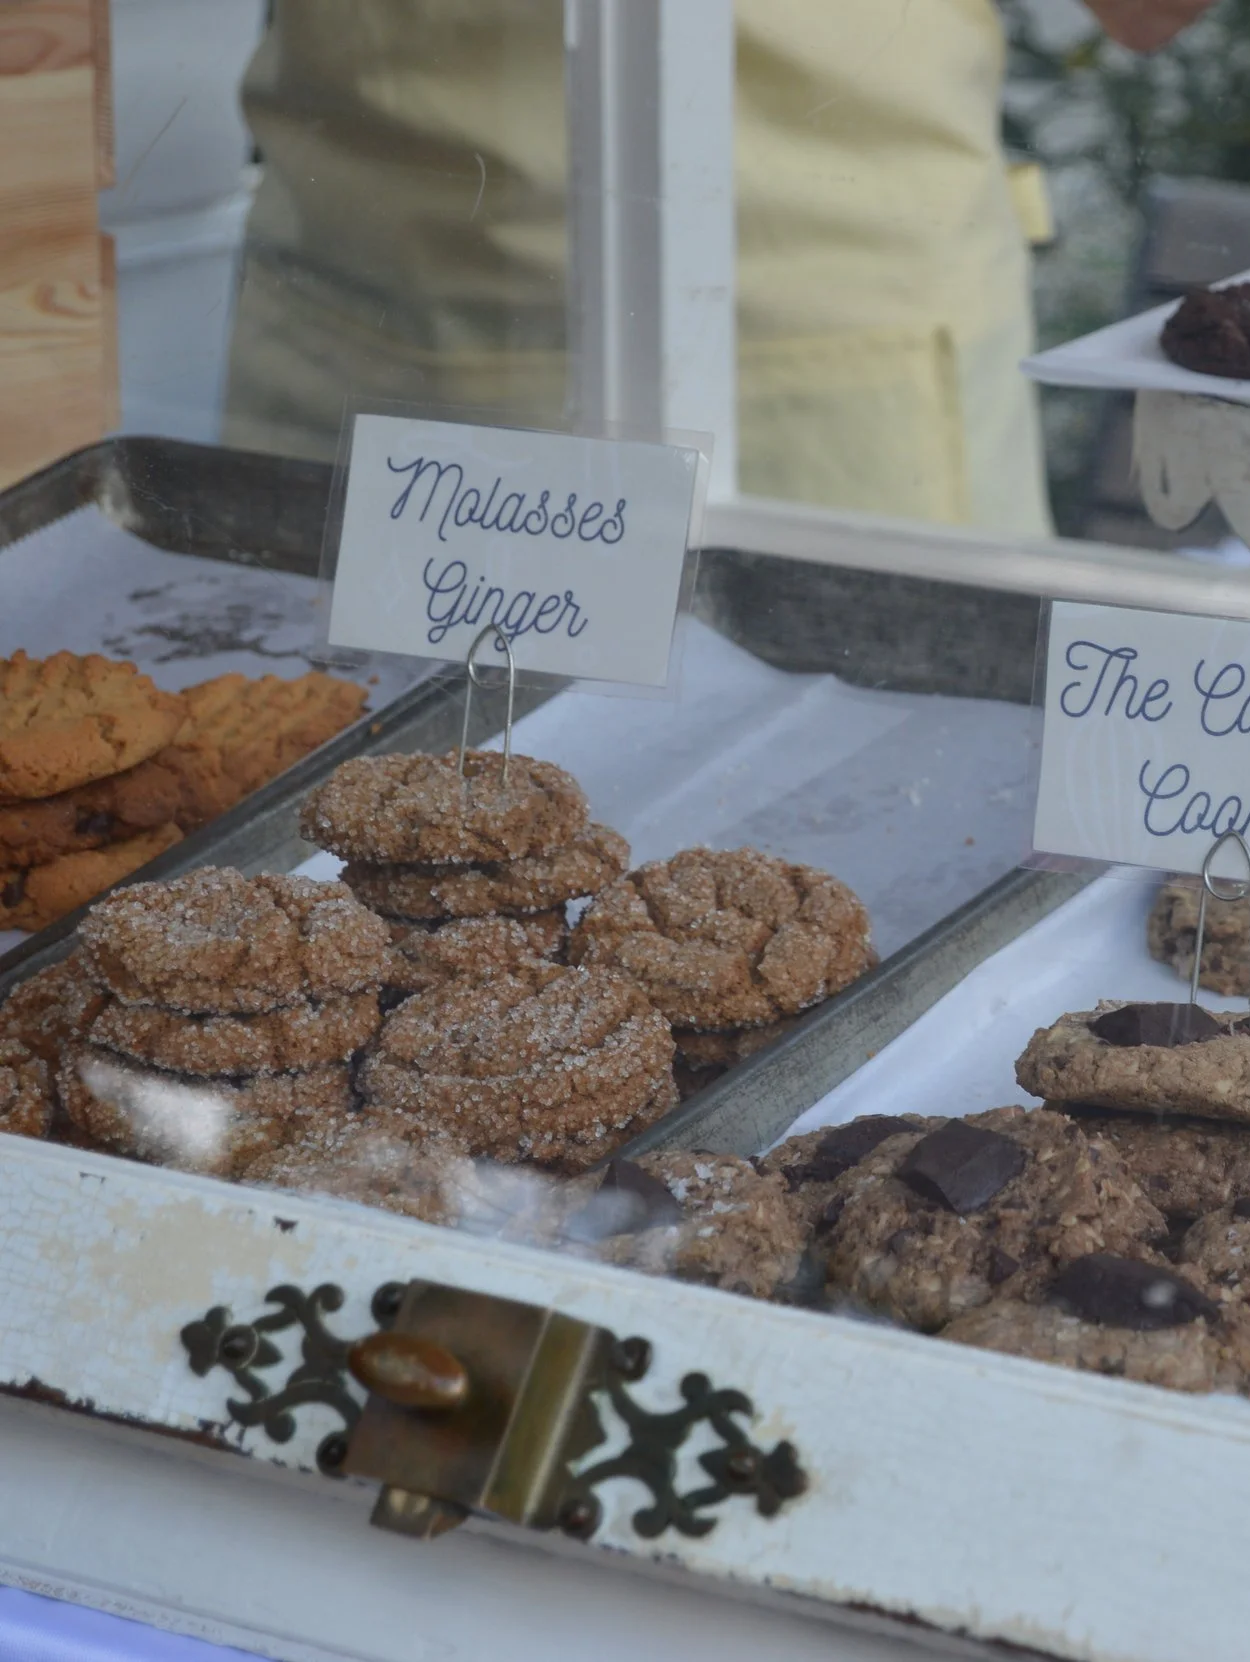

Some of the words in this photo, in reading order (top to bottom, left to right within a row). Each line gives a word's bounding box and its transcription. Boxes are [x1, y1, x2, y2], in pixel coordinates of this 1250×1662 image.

[387, 457, 626, 544] Molasses
[423, 557, 588, 652] Ginger
[1060, 640, 1173, 722] The
